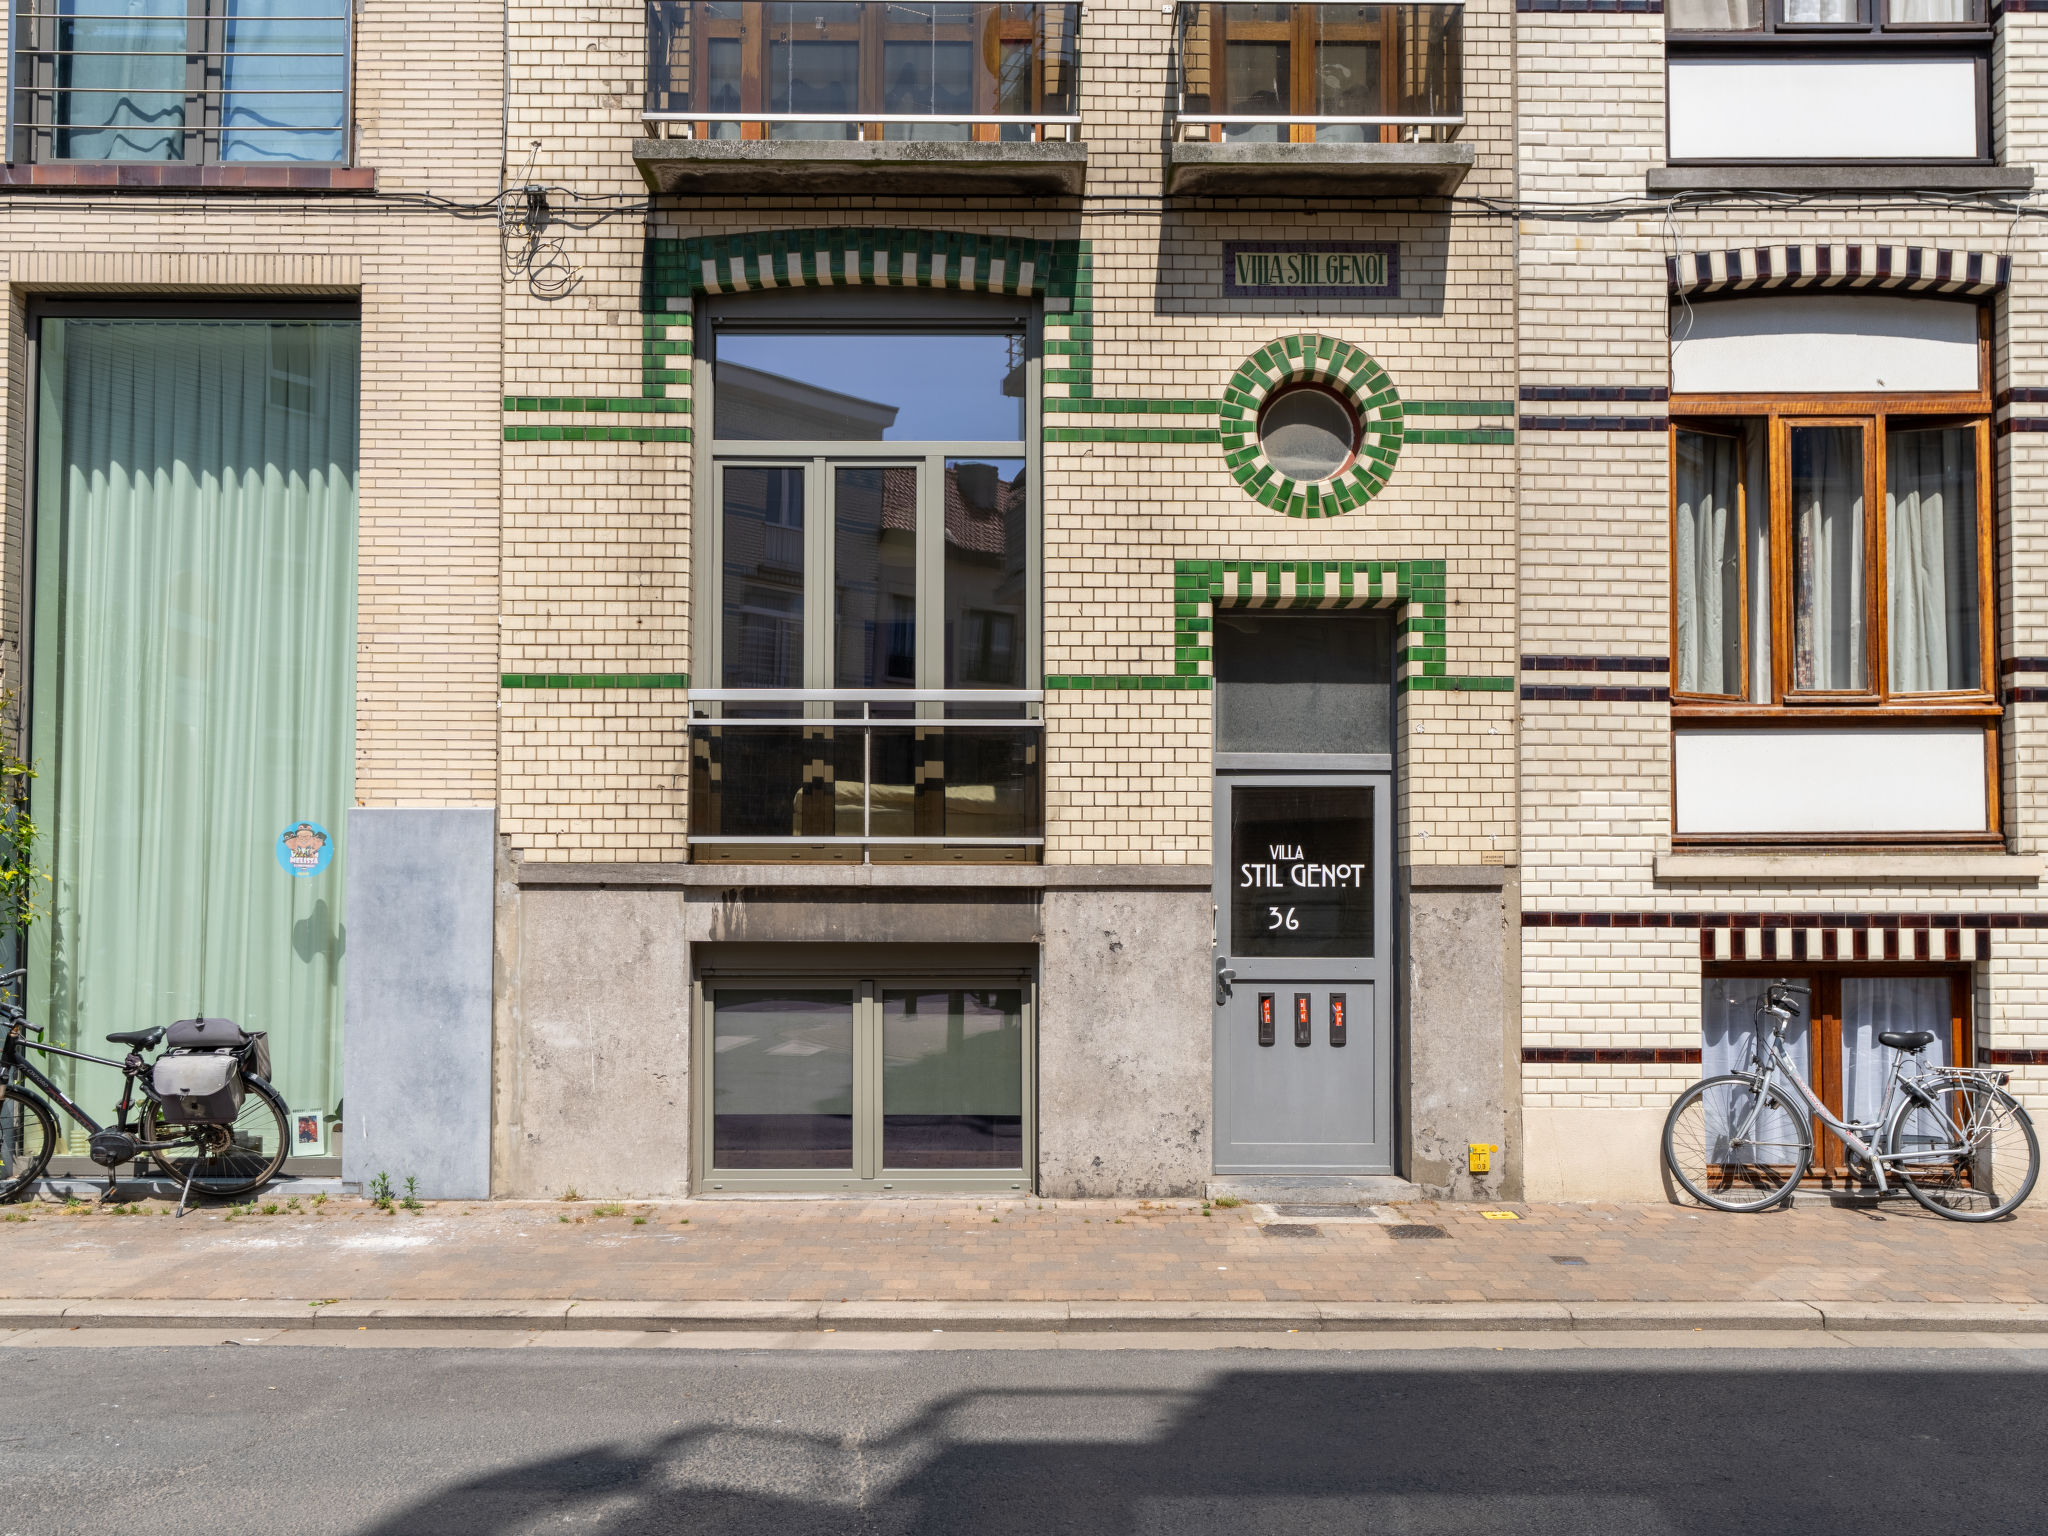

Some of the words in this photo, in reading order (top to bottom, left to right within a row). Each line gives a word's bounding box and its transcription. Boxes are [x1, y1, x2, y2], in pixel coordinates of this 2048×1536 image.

[1236, 254, 1284, 286] VILLA
[1287, 253, 1326, 285] STIL
[1326, 253, 1386, 285] GENOT
[1269, 844, 1304, 860] VILLA
[1240, 864, 1284, 888] STIL
[1291, 864, 1365, 888] GENOT
[1268, 906, 1299, 931] 36
